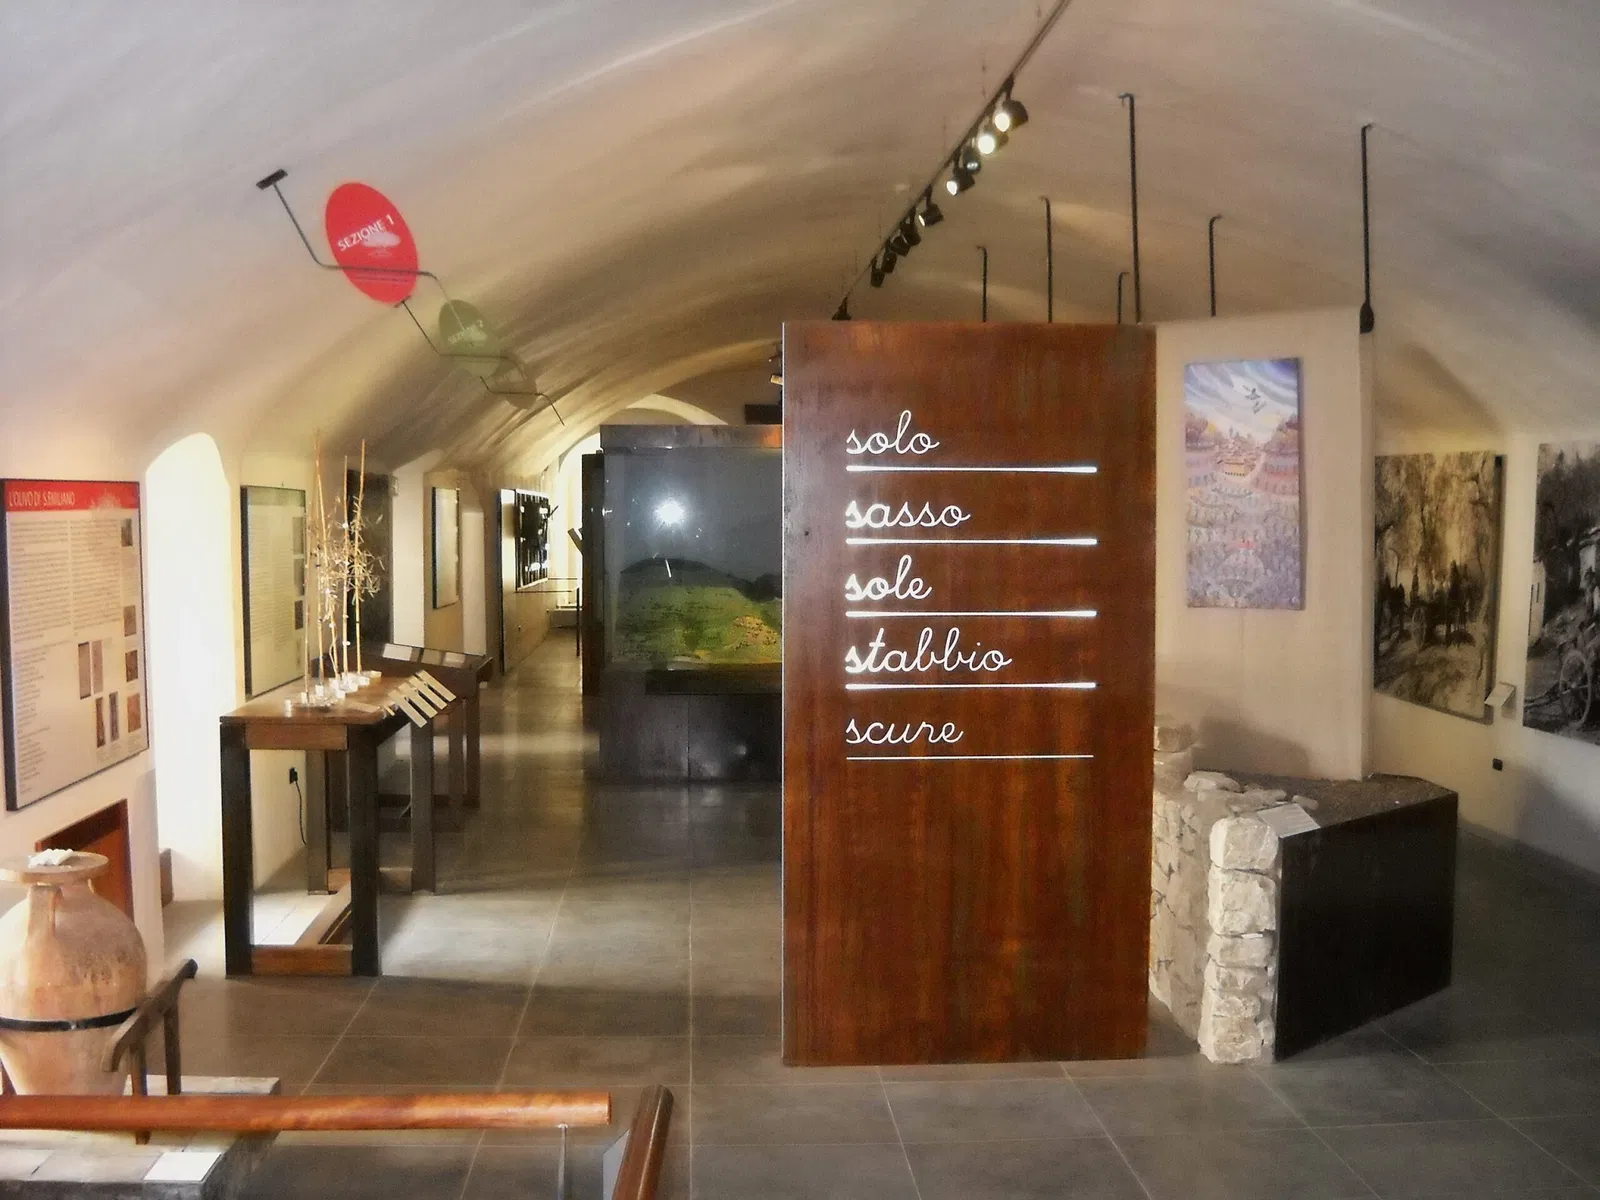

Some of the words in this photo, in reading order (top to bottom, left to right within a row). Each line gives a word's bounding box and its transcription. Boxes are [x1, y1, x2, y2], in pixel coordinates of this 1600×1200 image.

[338, 219, 385, 252] SEZIONE
[386, 213, 394, 225] 1
[845, 410, 940, 455] solo
[845, 500, 971, 528] sasso
[845, 555, 932, 601] sole
[845, 627, 1012, 674] stabbio
[845, 718, 964, 745] scure
